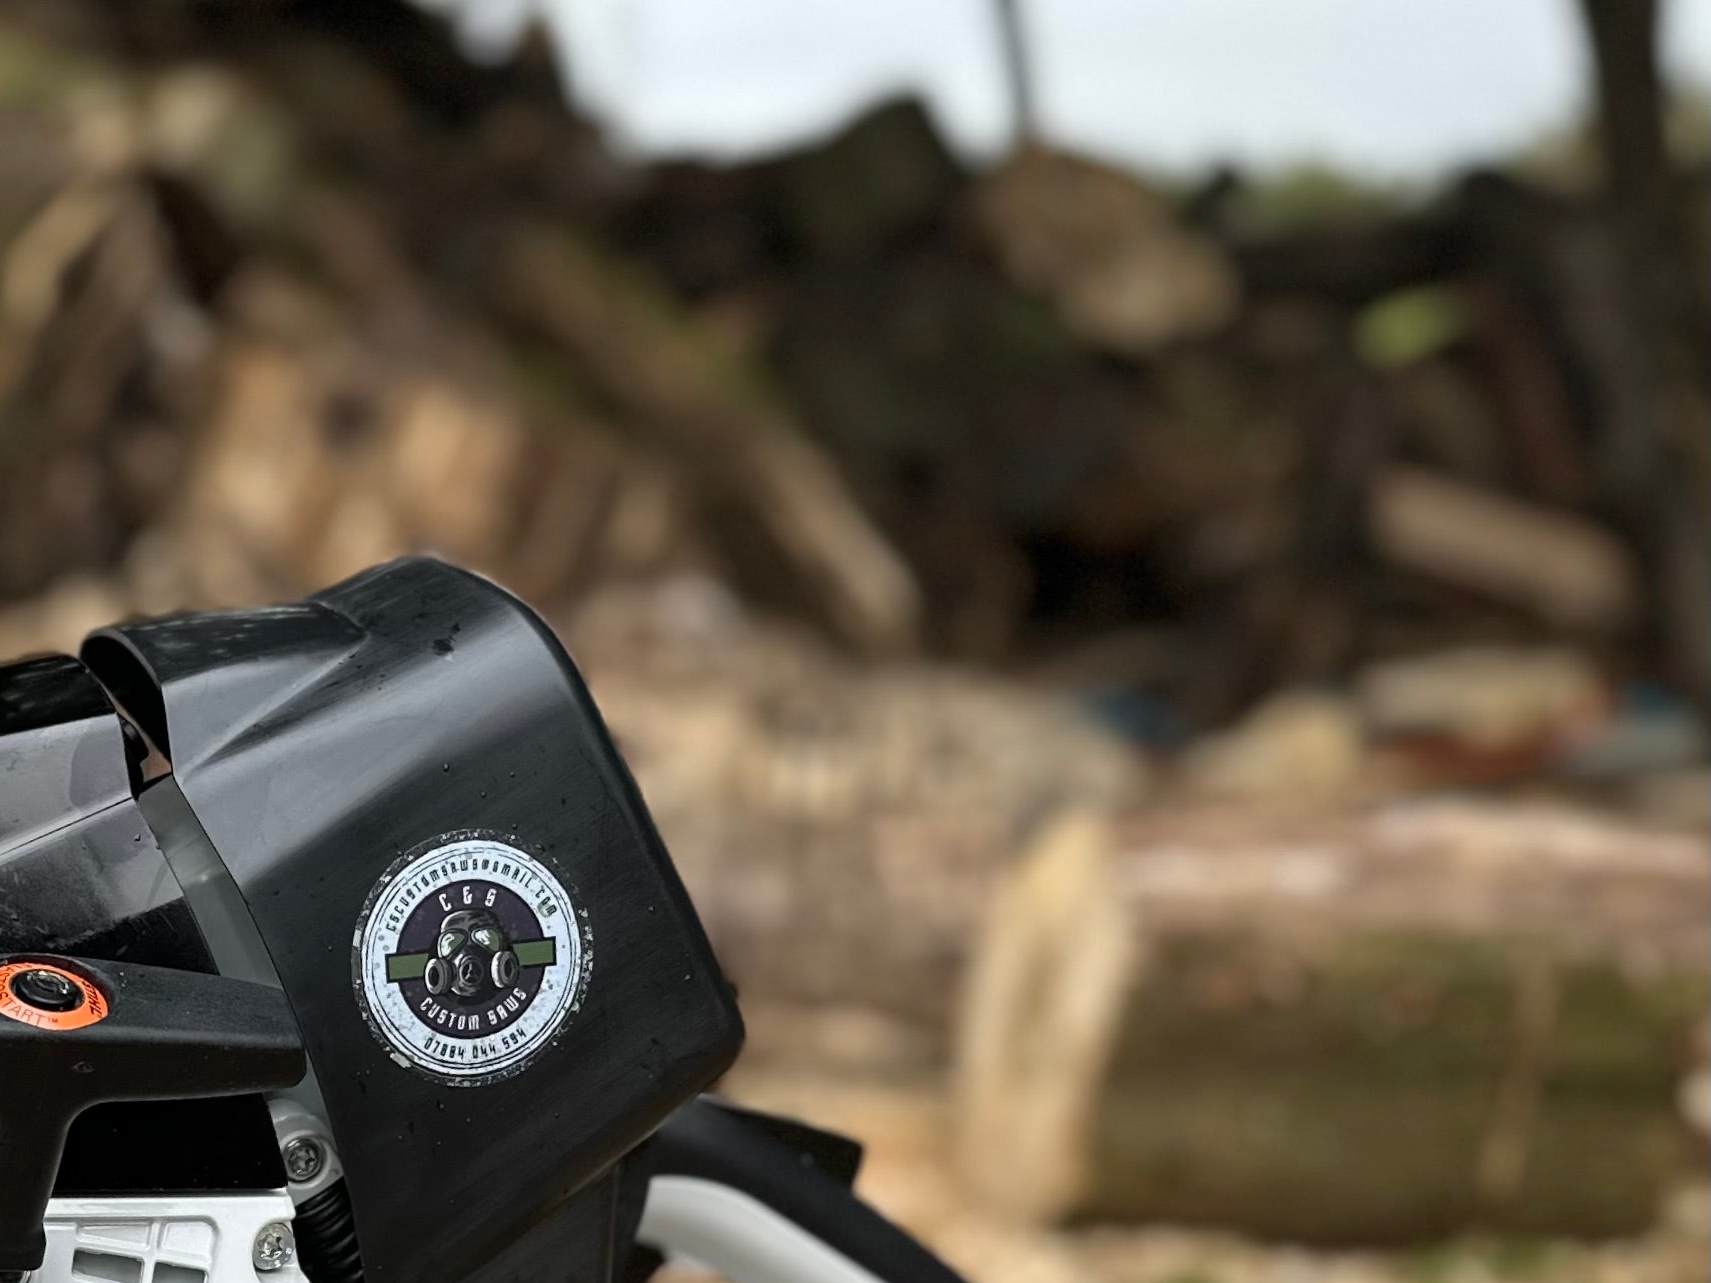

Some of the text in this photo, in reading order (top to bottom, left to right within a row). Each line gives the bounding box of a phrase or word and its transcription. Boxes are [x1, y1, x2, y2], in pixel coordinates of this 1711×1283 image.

[439, 886, 497, 911] C & S
[419, 987, 527, 1030] CUSTOM SAWS
[472, 1044, 496, 1059] 044
